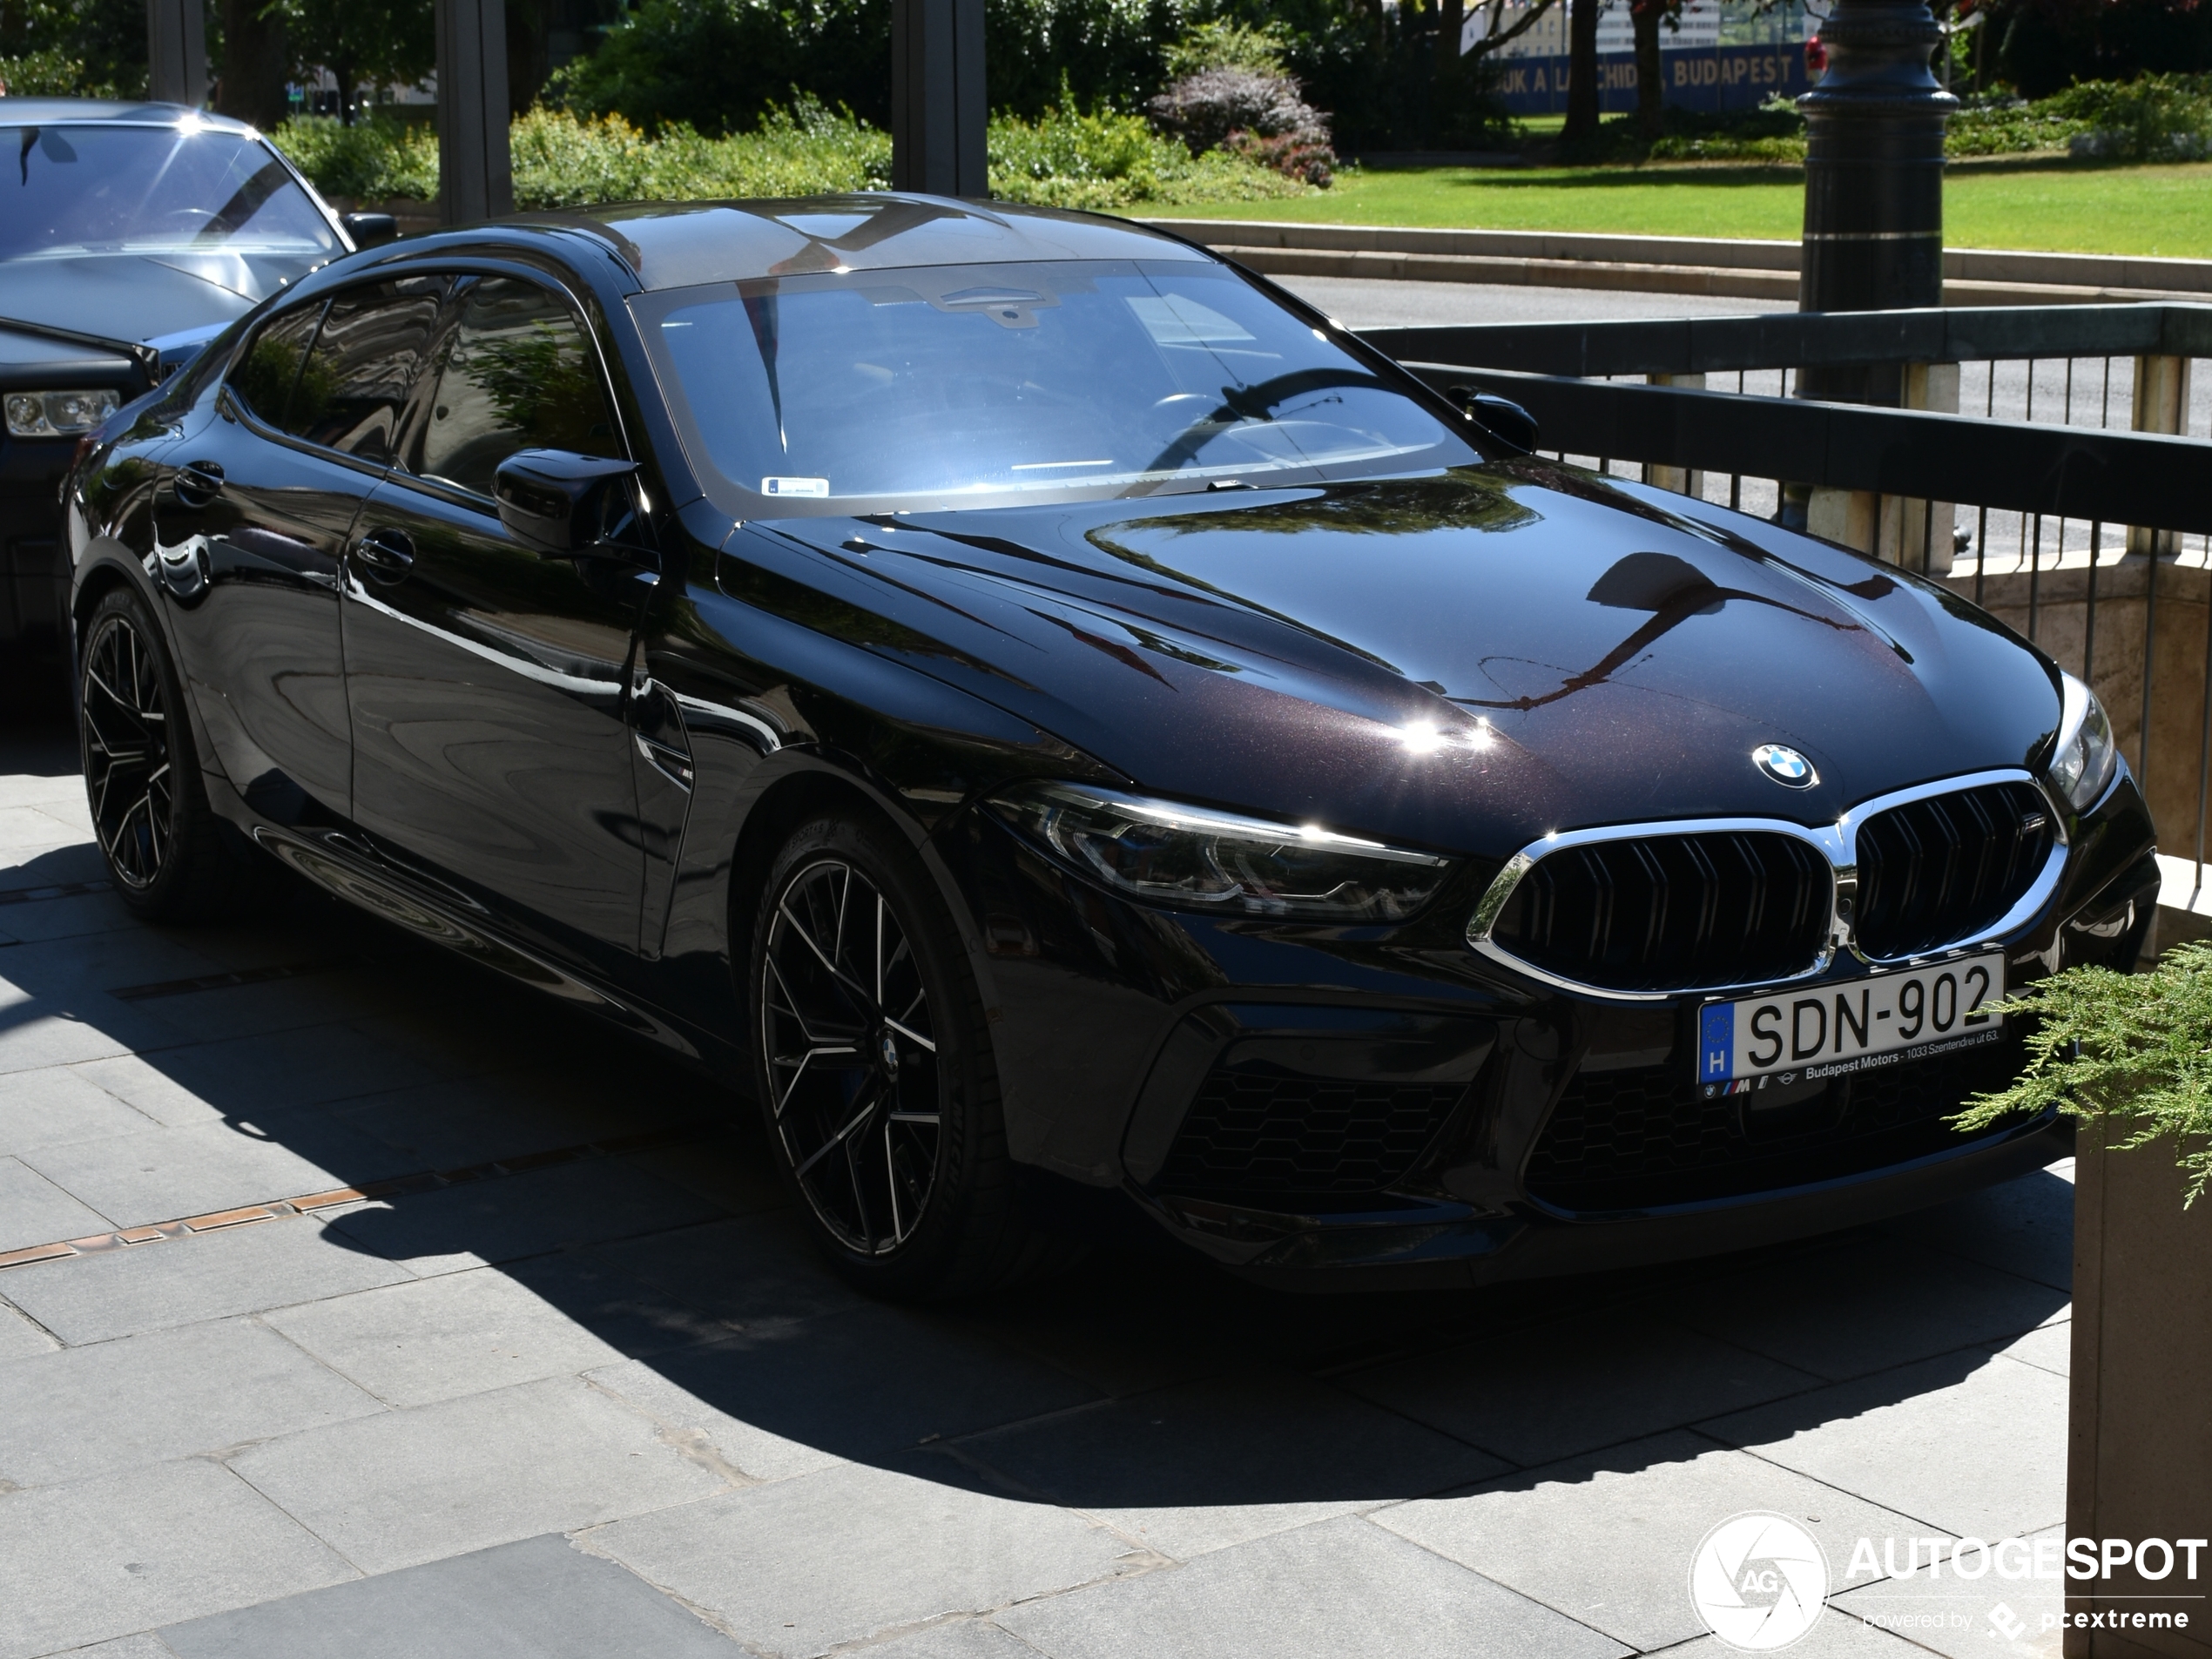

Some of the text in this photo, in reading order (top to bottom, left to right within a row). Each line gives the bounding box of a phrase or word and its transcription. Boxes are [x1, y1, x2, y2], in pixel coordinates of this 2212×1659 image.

[1534, 67, 1547, 91] A
[1674, 55, 1792, 86] BUDAPEST
[1748, 965, 1990, 1068] SDN-902
[1710, 1050, 1724, 1073] H
[1805, 1060, 1858, 1080] Budapest
[1861, 1052, 1899, 1069] Motors
[1906, 1045, 1927, 1060] 1033
[1928, 1034, 1976, 1055] Szentendrei
[1986, 1029, 1999, 1042] 63.
